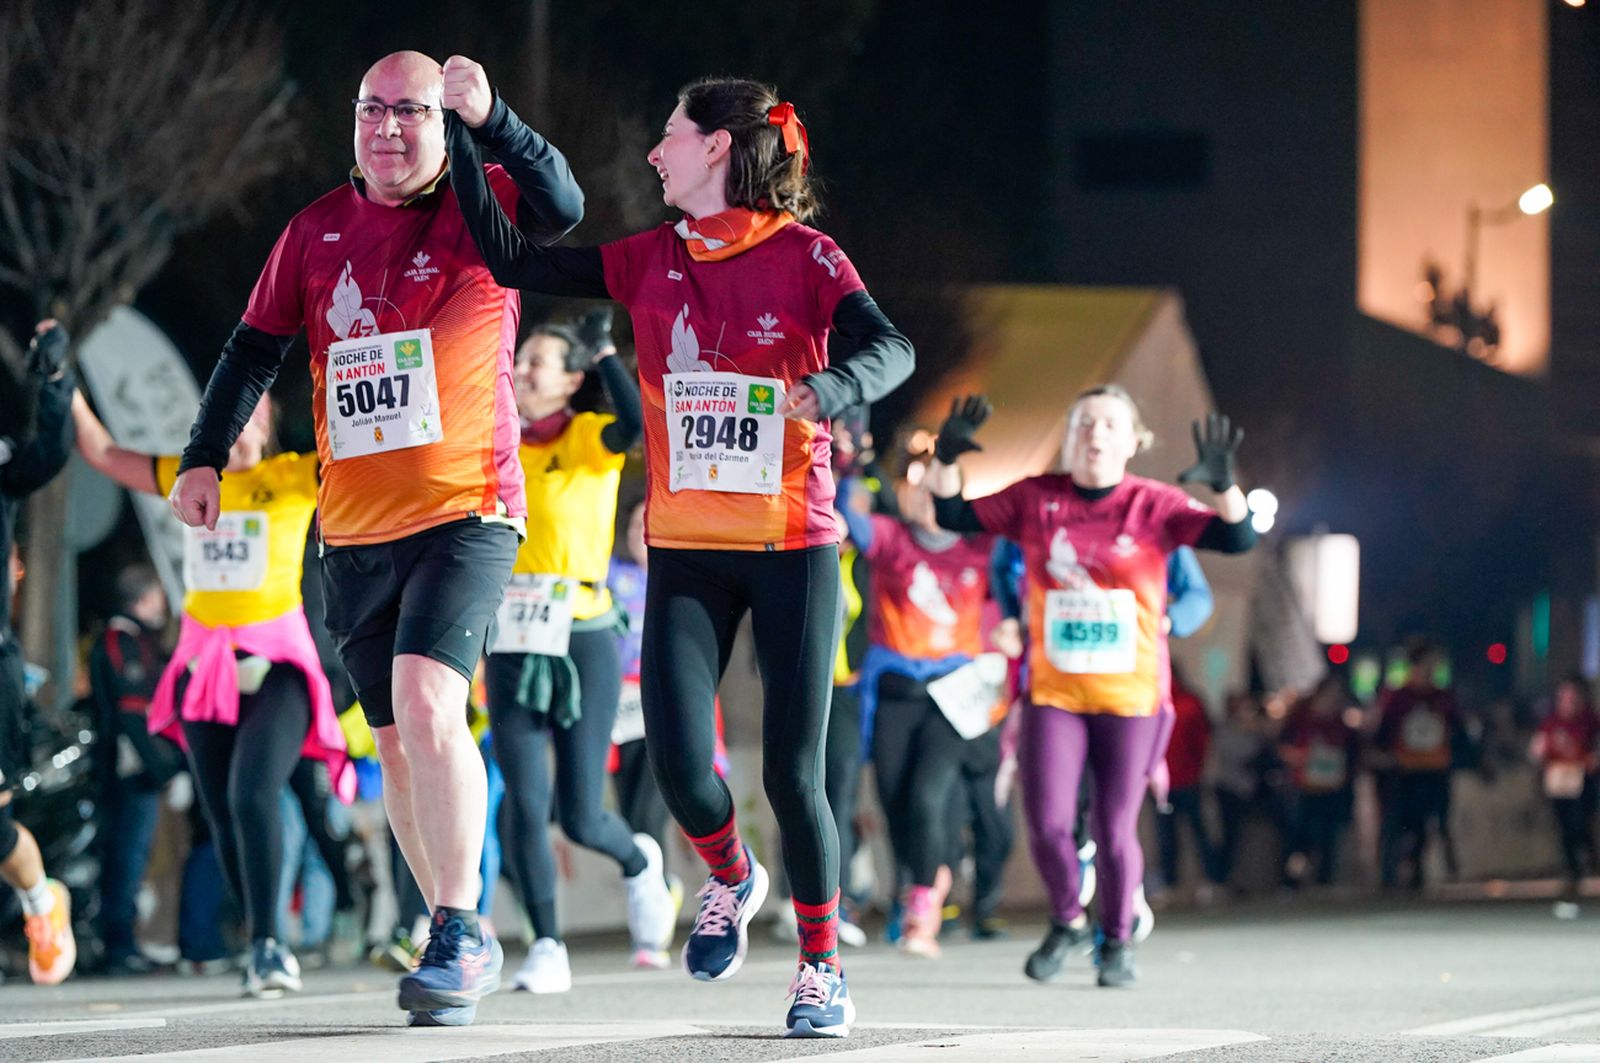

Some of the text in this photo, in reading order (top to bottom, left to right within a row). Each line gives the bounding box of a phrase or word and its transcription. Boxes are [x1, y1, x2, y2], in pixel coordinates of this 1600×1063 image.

[333, 351, 367, 366] NOCHE
[370, 349, 383, 360] DE
[346, 361, 385, 380] ANTÓN
[336, 374, 410, 417] 5047
[685, 385, 737, 397] NOCHE DE
[675, 398, 737, 413] SAN ANTÓN
[352, 411, 401, 427] Julián Manuel
[681, 415, 759, 452] 2948
[704, 452, 717, 461] del
[719, 453, 749, 463] Carmen
[203, 541, 249, 561] 1543
[1061, 622, 1118, 643] 4599
